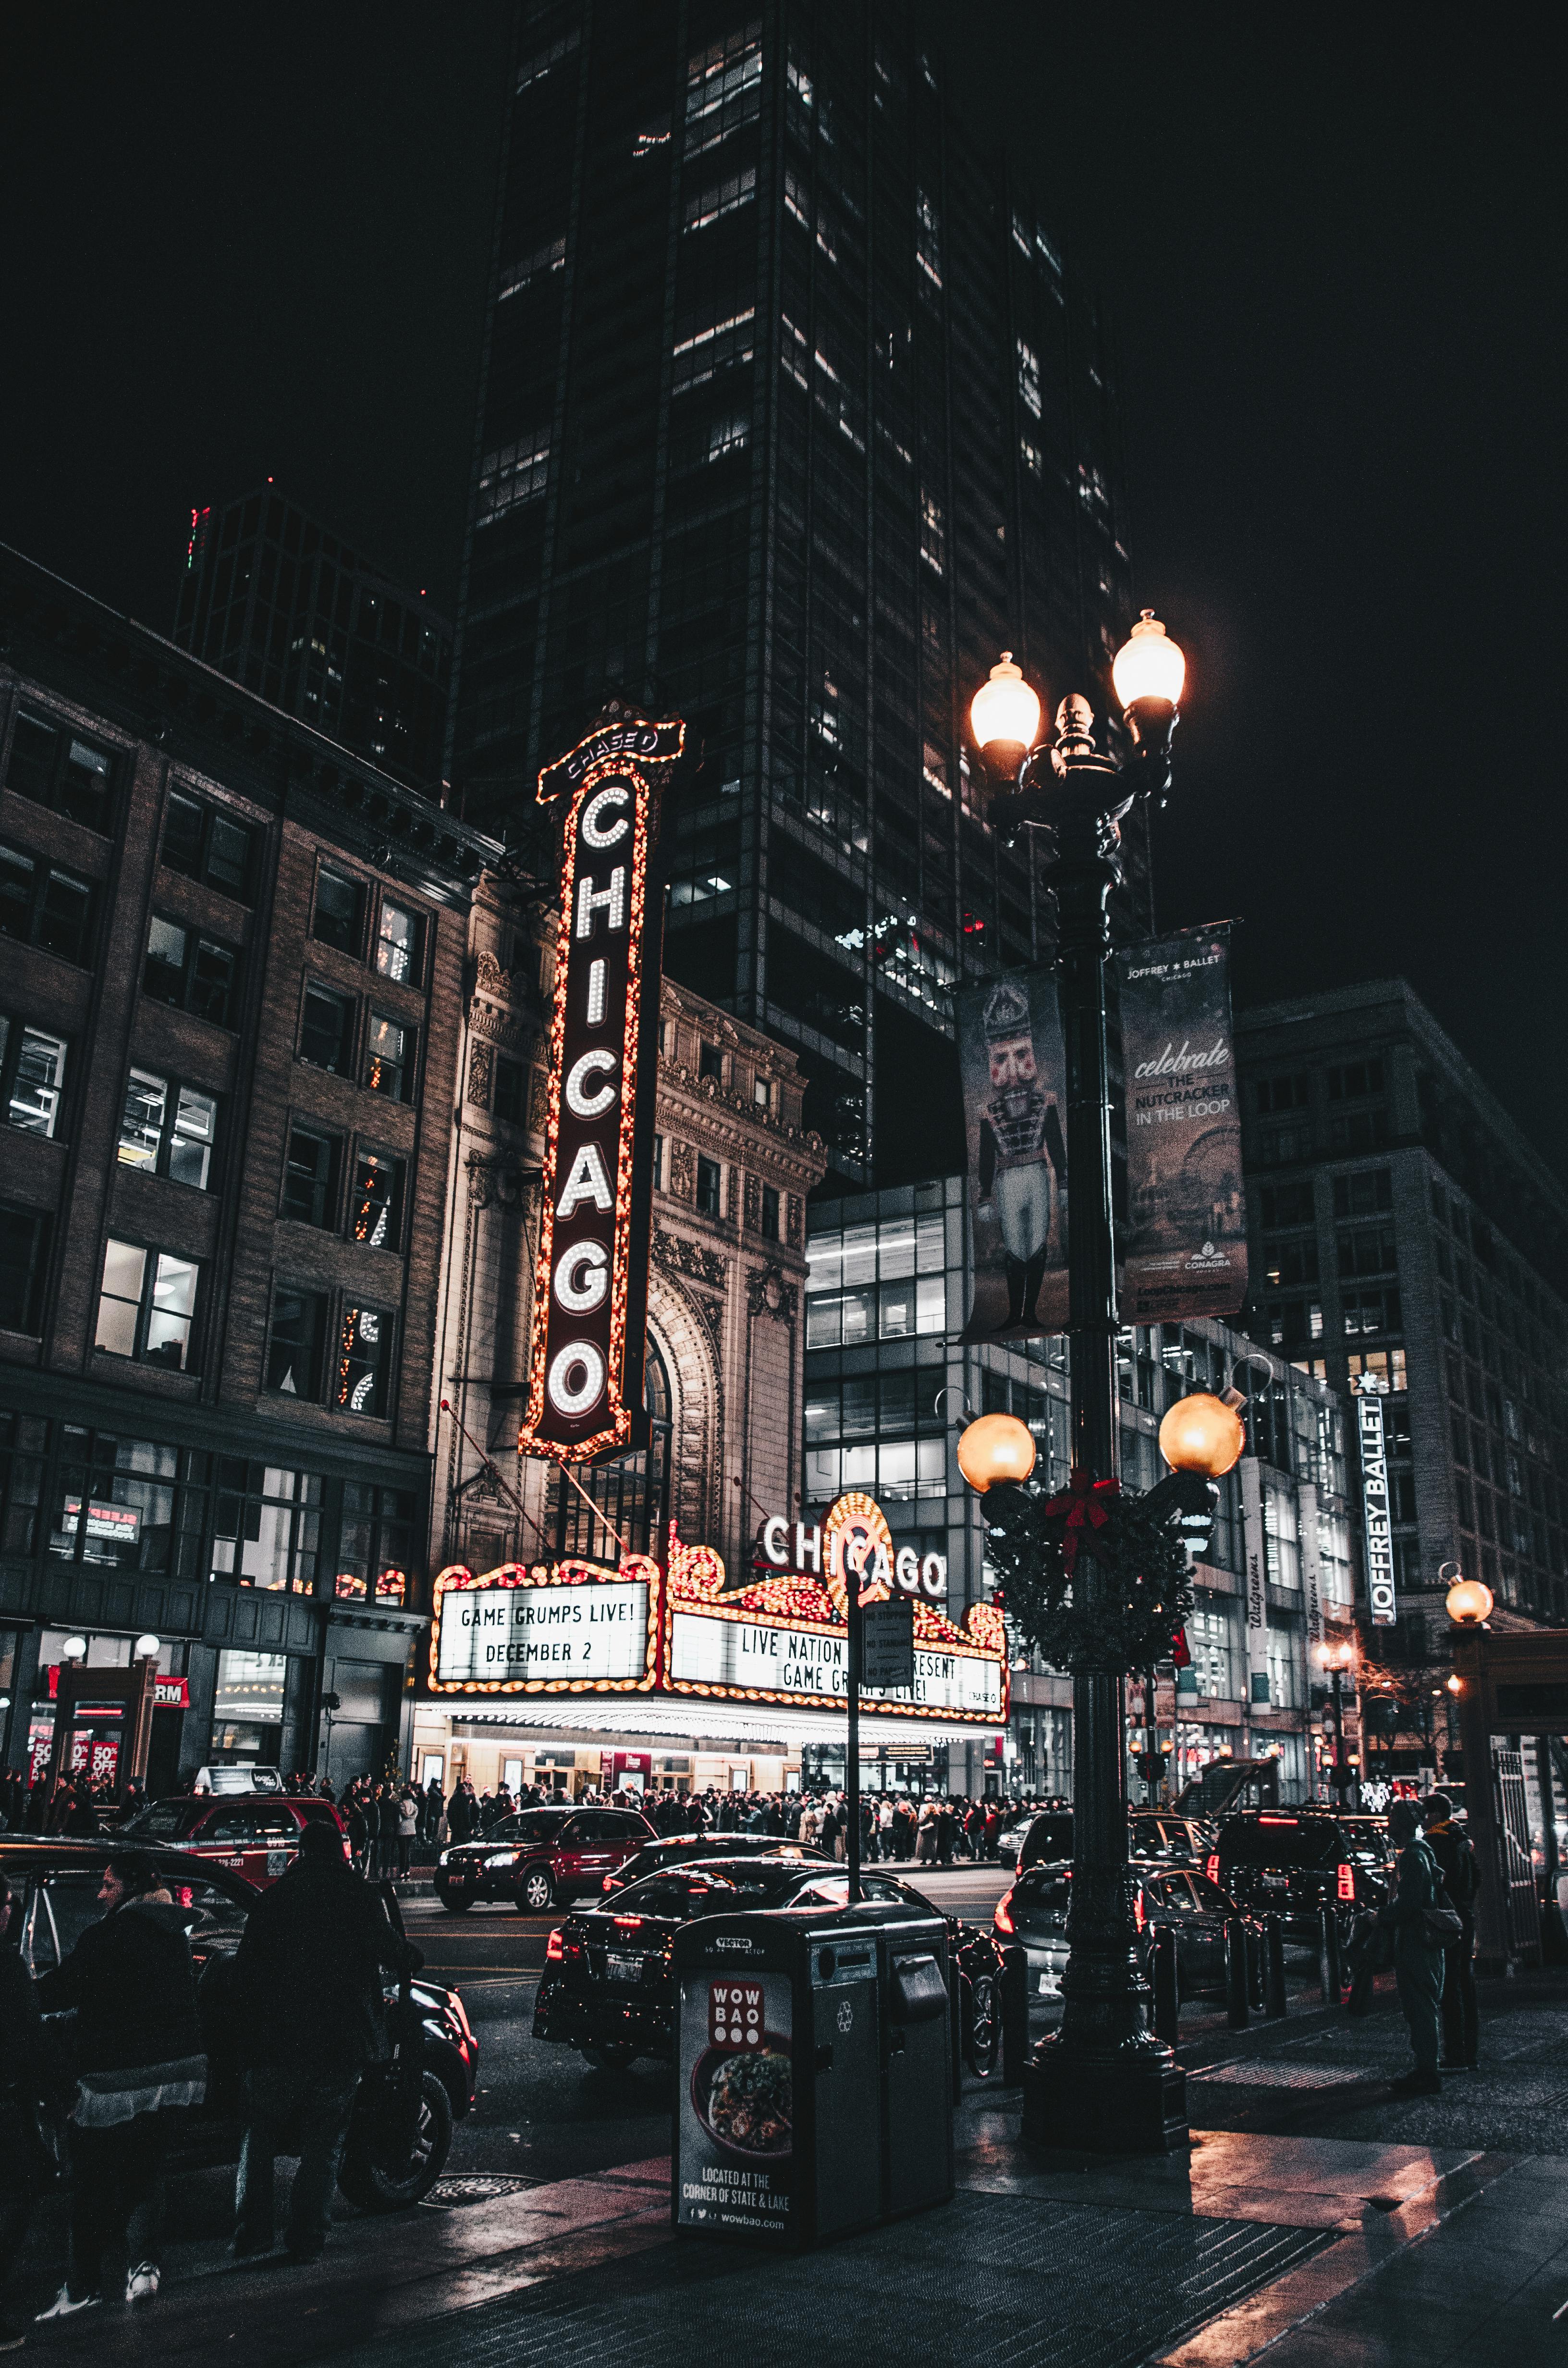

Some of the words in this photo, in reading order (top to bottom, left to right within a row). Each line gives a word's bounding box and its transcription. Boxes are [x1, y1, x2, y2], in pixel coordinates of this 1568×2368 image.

[1127, 964, 1169, 979] JOFFREY
[1183, 955, 1219, 968] BALLET
[1162, 972, 1191, 982] CHICAGO
[1135, 1038, 1228, 1078] celebrate
[1168, 1073, 1194, 1087] THE
[548, 787, 629, 1414] CHICAGO
[1136, 1084, 1229, 1108] NUTCRACKER
[1137, 1112, 1151, 1125] IN
[1156, 1107, 1184, 1122] THE
[1188, 1099, 1230, 1118] LOOP
[1185, 1259, 1231, 1270] CONAGRA
[1360, 1400, 1385, 1495] BALLET
[764, 1515, 945, 1595] CHICAGO
[1366, 1503, 1393, 1622] JOFFREY
[1250, 1554, 1264, 1629] Walgreens
[462, 1608, 505, 1627] GAME
[515, 1605, 582, 1626] GRUMPS
[590, 1603, 634, 1622] LIVE!
[486, 1643, 572, 1663] DECEMBER
[582, 1642, 592, 1660] 2
[743, 1628, 778, 1656] LIVE
[788, 1635, 841, 1665] NATION
[913, 1653, 956, 1679] RESENT
[784, 1663, 823, 1690] GAME
[868, 1668, 877, 1677] NO
[969, 1691, 989, 1702] CHASE
[93, 1746, 118, 1760] 50%
[92, 1760, 116, 1771] OFF
[718, 1938, 750, 1947] VECTOR
[713, 1988, 760, 2006] WOW
[715, 2007, 759, 2024] BAO
[702, 2167, 739, 2185] LOCATED
[741, 2172, 752, 2187] AT
[754, 2173, 770, 2190] THE
[683, 2183, 717, 2202] CORNER
[719, 2187, 730, 2203] OF
[732, 2189, 757, 2207] STATE
[759, 2193, 766, 2208] &
[768, 2194, 790, 2211] LAKE
[722, 2214, 784, 2230] wowbao.com
